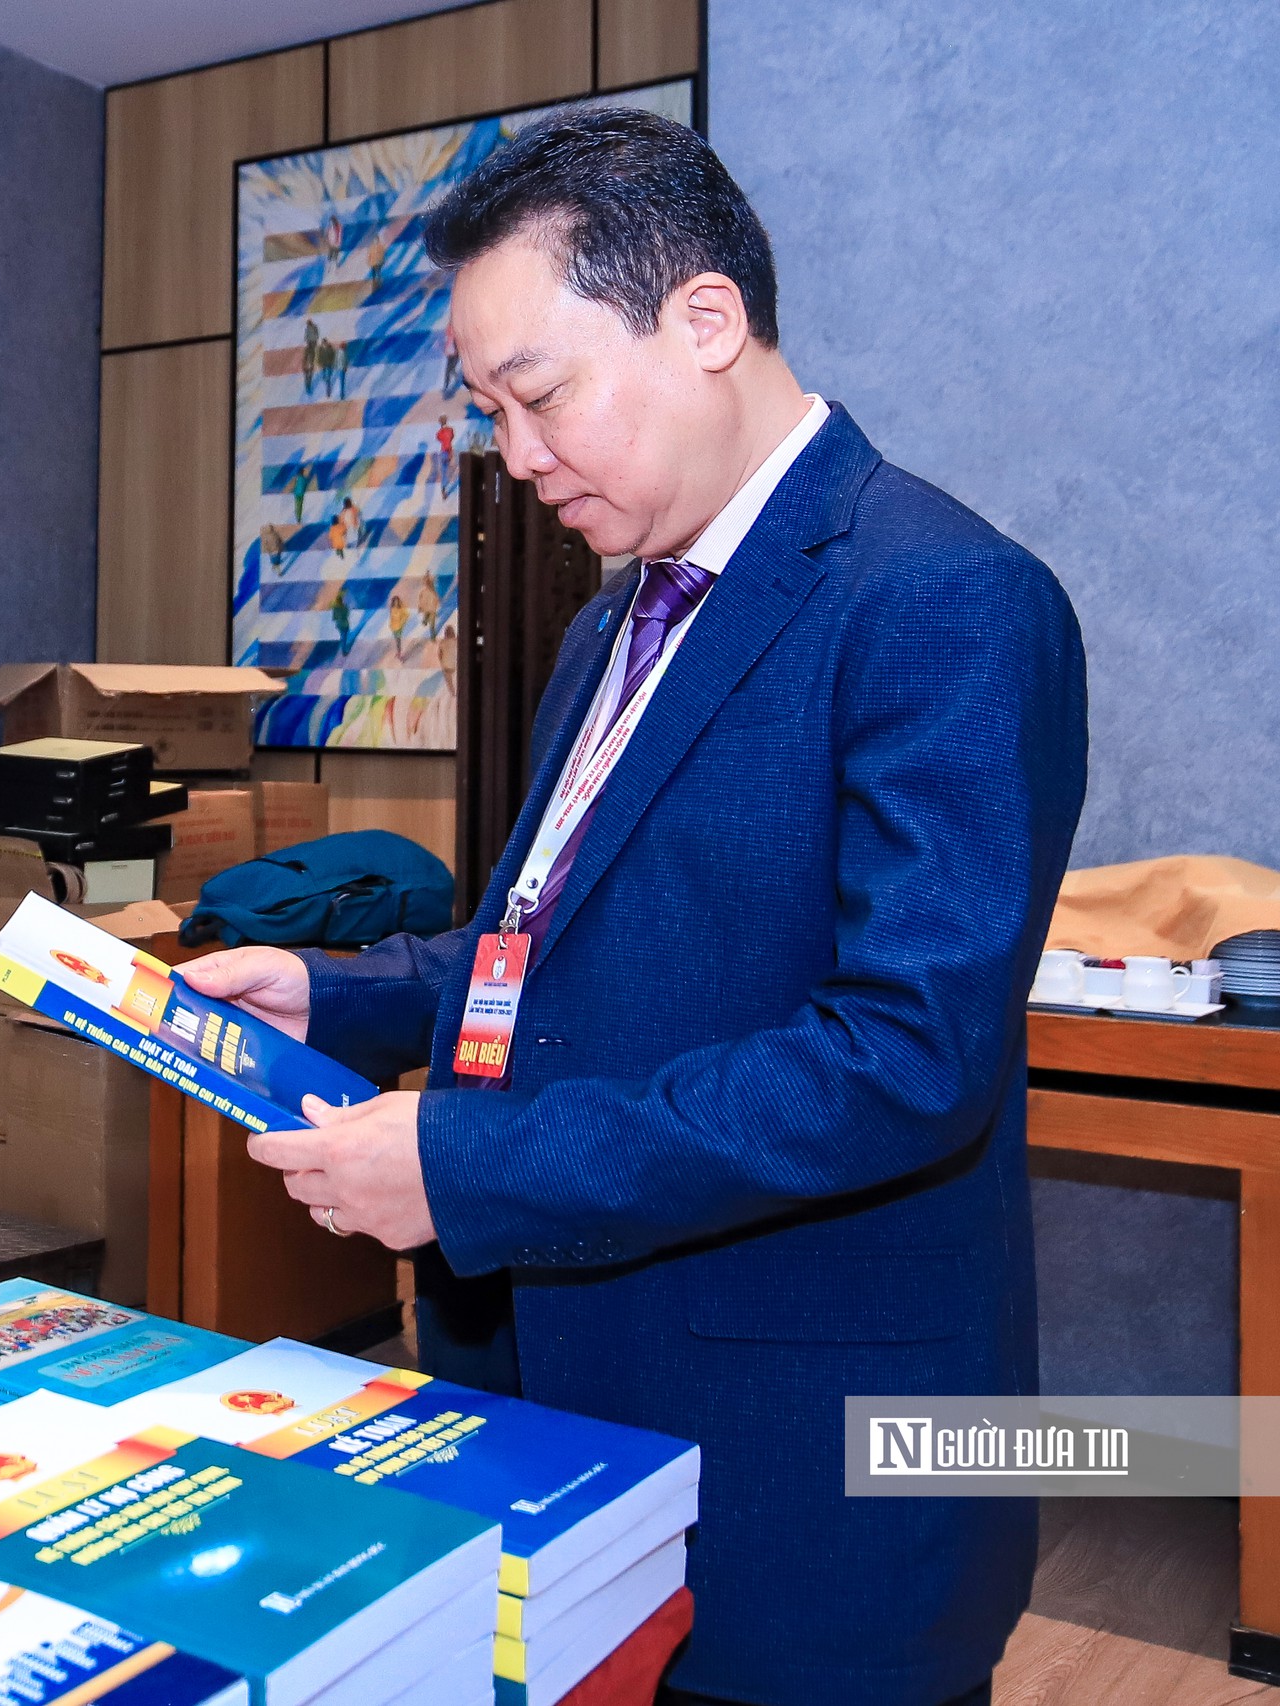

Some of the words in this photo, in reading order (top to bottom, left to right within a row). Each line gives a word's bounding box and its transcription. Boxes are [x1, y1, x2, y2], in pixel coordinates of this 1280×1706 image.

[138, 1038, 160, 1056] LUẬT
[160, 1048, 174, 1065] KẾ
[174, 1056, 198, 1078] TOÁN
[458, 1040, 476, 1066] ĐẠI
[478, 1035, 505, 1065] BIỂU
[64, 1010, 76, 1025] VÀ
[75, 1017, 88, 1032] HỆ
[86, 1023, 112, 1046] THỐNG
[112, 1038, 130, 1055] CÁC
[129, 1048, 146, 1064] VĂN
[144, 1056, 164, 1074] BẢN
[161, 1067, 180, 1083] QUY
[178, 1075, 200, 1094] ĐỊNH
[198, 1086, 215, 1102] CHI
[213, 1096, 232, 1112] TIẾT
[230, 1105, 246, 1120] THI
[244, 1113, 268, 1133] HÀNH
[293, 1405, 363, 1437] LUẬT
[328, 1432, 373, 1455] KẾ
[353, 1413, 418, 1442] TOÁN
